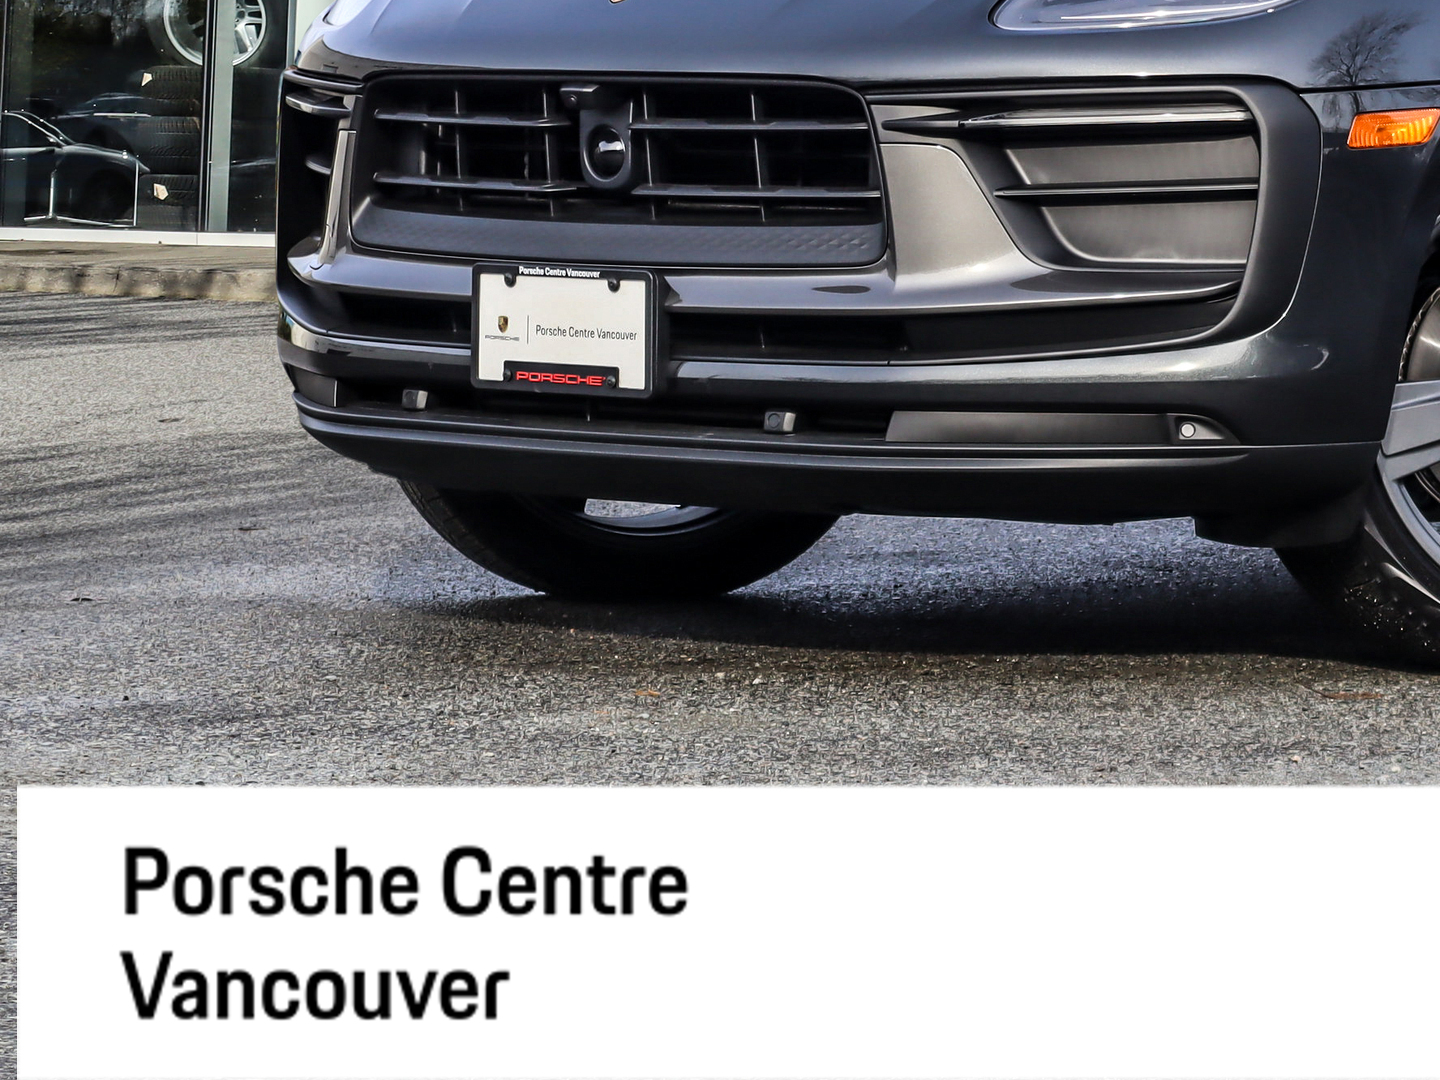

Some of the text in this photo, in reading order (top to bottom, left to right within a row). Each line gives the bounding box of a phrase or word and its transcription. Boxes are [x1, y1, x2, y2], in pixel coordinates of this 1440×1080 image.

[518, 266, 600, 278] Porsche Centre Vancouver
[535, 324, 637, 341] Porsche Centre Vancouver
[516, 371, 604, 386] PORSCHE
